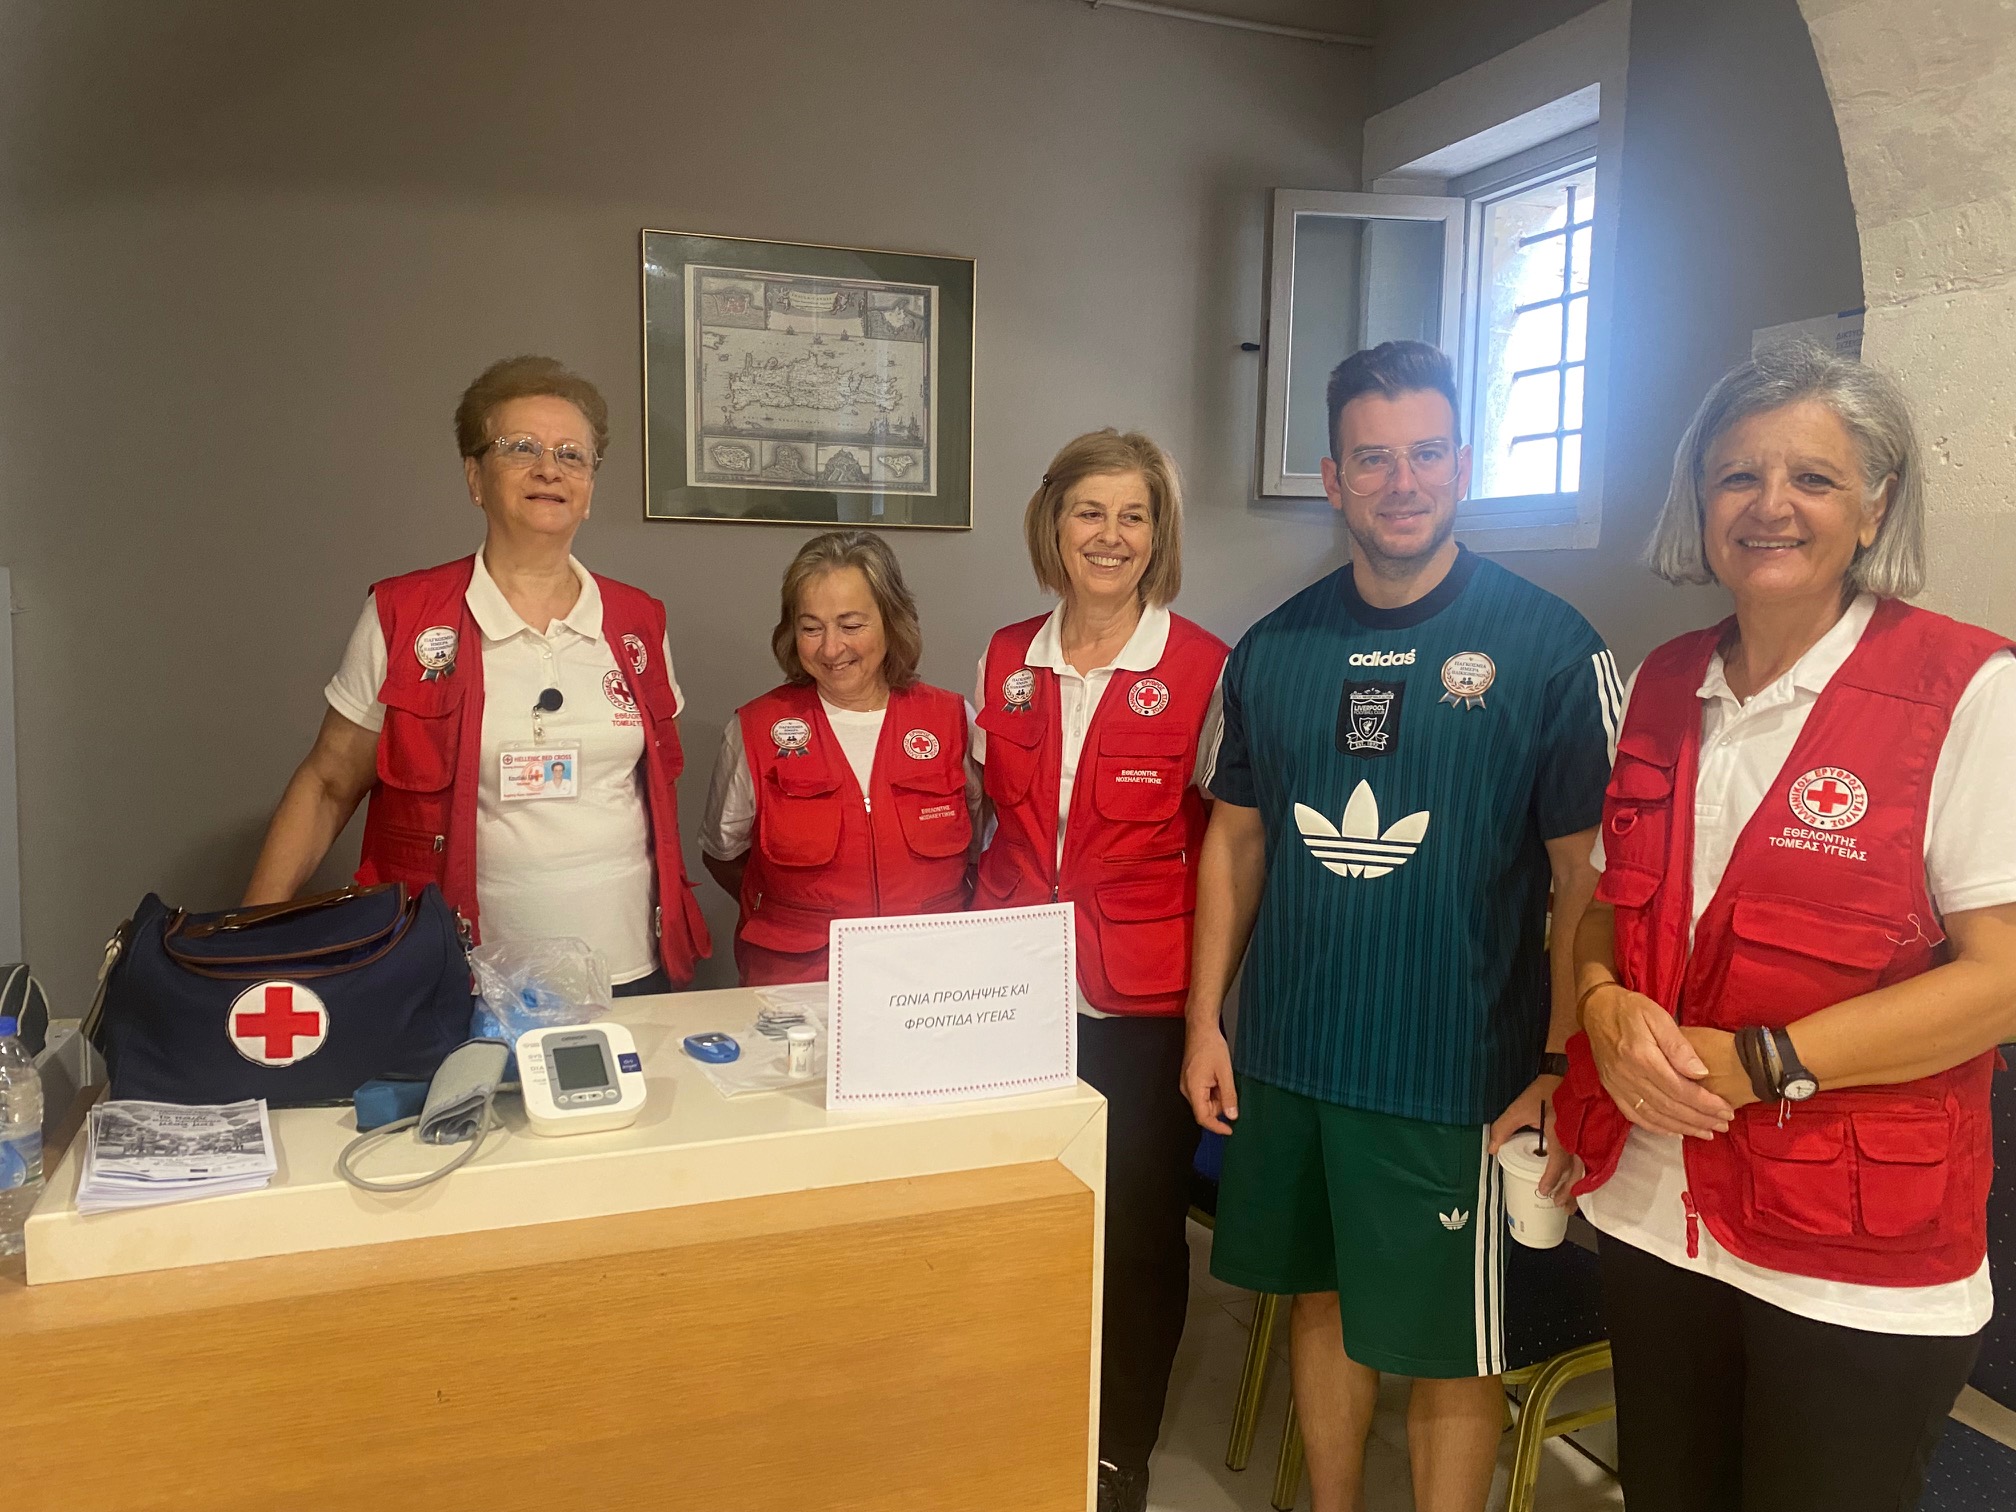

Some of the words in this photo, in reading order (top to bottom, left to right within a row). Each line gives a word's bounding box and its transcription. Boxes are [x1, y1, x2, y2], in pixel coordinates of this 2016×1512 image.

[1349, 649, 1416, 667] adidas
[1115, 776, 1162, 785] ΝΟΣΗΛΕΥΤΙΚΗΣ
[1121, 769, 1158, 777] ΕΘΕΛΟΝΤΗΣ
[1814, 767, 1862, 792] ΕΡΥΘΡΟΣ
[1791, 775, 1816, 825] ΕΛΛΗΝΙΚΟΣ
[1830, 793, 1864, 828] ΣΤΑΥΡΟΣ
[1768, 836, 1820, 852] ΤΟΜΕΑΣ
[1823, 843, 1868, 862] ΥΓΕΙΑΣ
[1782, 827, 1858, 849] ΕΘΕΛΟΝΤΗΣ
[889, 992, 931, 1007] ΓΩΝΙΑ
[933, 985, 1009, 1004] ΠΡΟΛΗΨΗΣ
[1010, 983, 1030, 997] ΚΑΙ
[904, 1013, 973, 1029] ΦΡΟΝΤΙΔΑ
[976, 1008, 1017, 1023] ΥΓΕΙΑΣ
